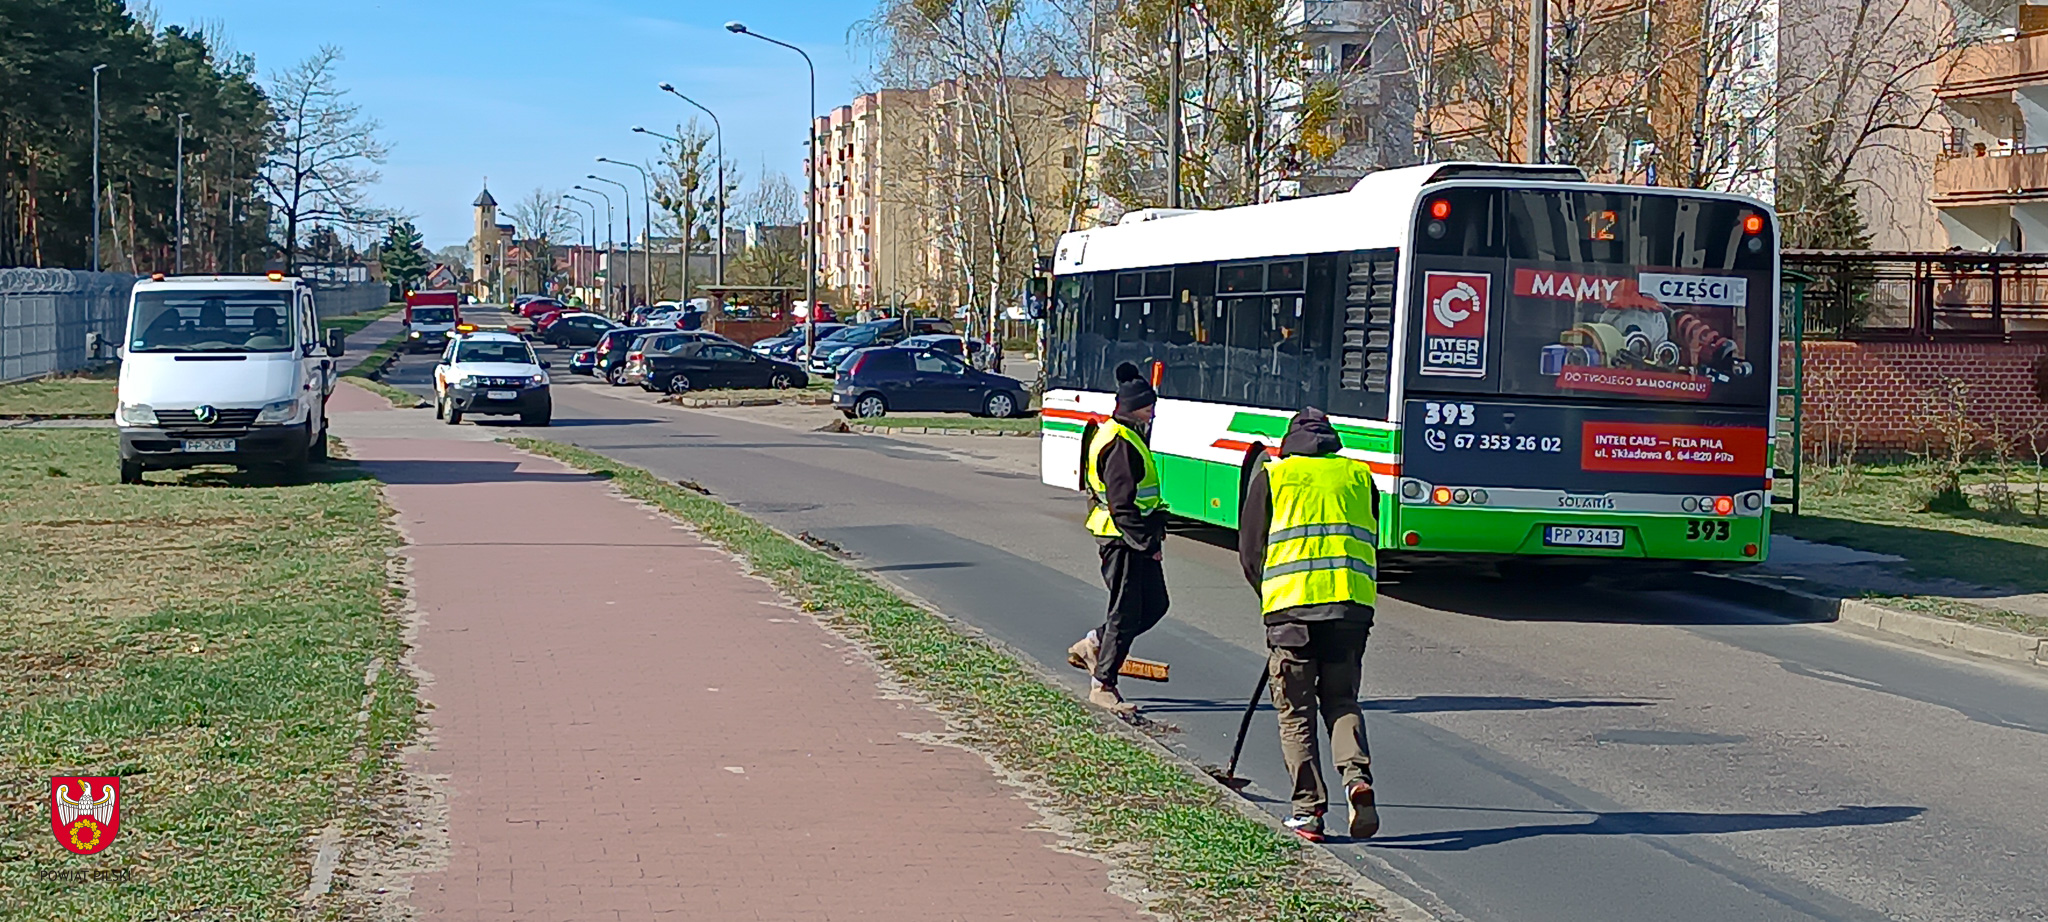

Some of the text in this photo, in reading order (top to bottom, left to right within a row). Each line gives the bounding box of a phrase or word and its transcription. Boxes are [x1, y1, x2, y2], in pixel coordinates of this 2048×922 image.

[1585, 210, 1618, 240] 12
[1532, 273, 1619, 301] MAMY
[1659, 278, 1729, 302] CZĘŚCI
[1429, 337, 1480, 353] INTER
[1428, 351, 1478, 366] CARS
[1564, 371, 1582, 382] DO
[1424, 402, 1475, 426] 393
[1454, 433, 1562, 452] 67 353 26 02
[1558, 496, 1615, 509] SOLARIS
[1554, 528, 1621, 544] PP 93413
[1686, 520, 1730, 541] 393
